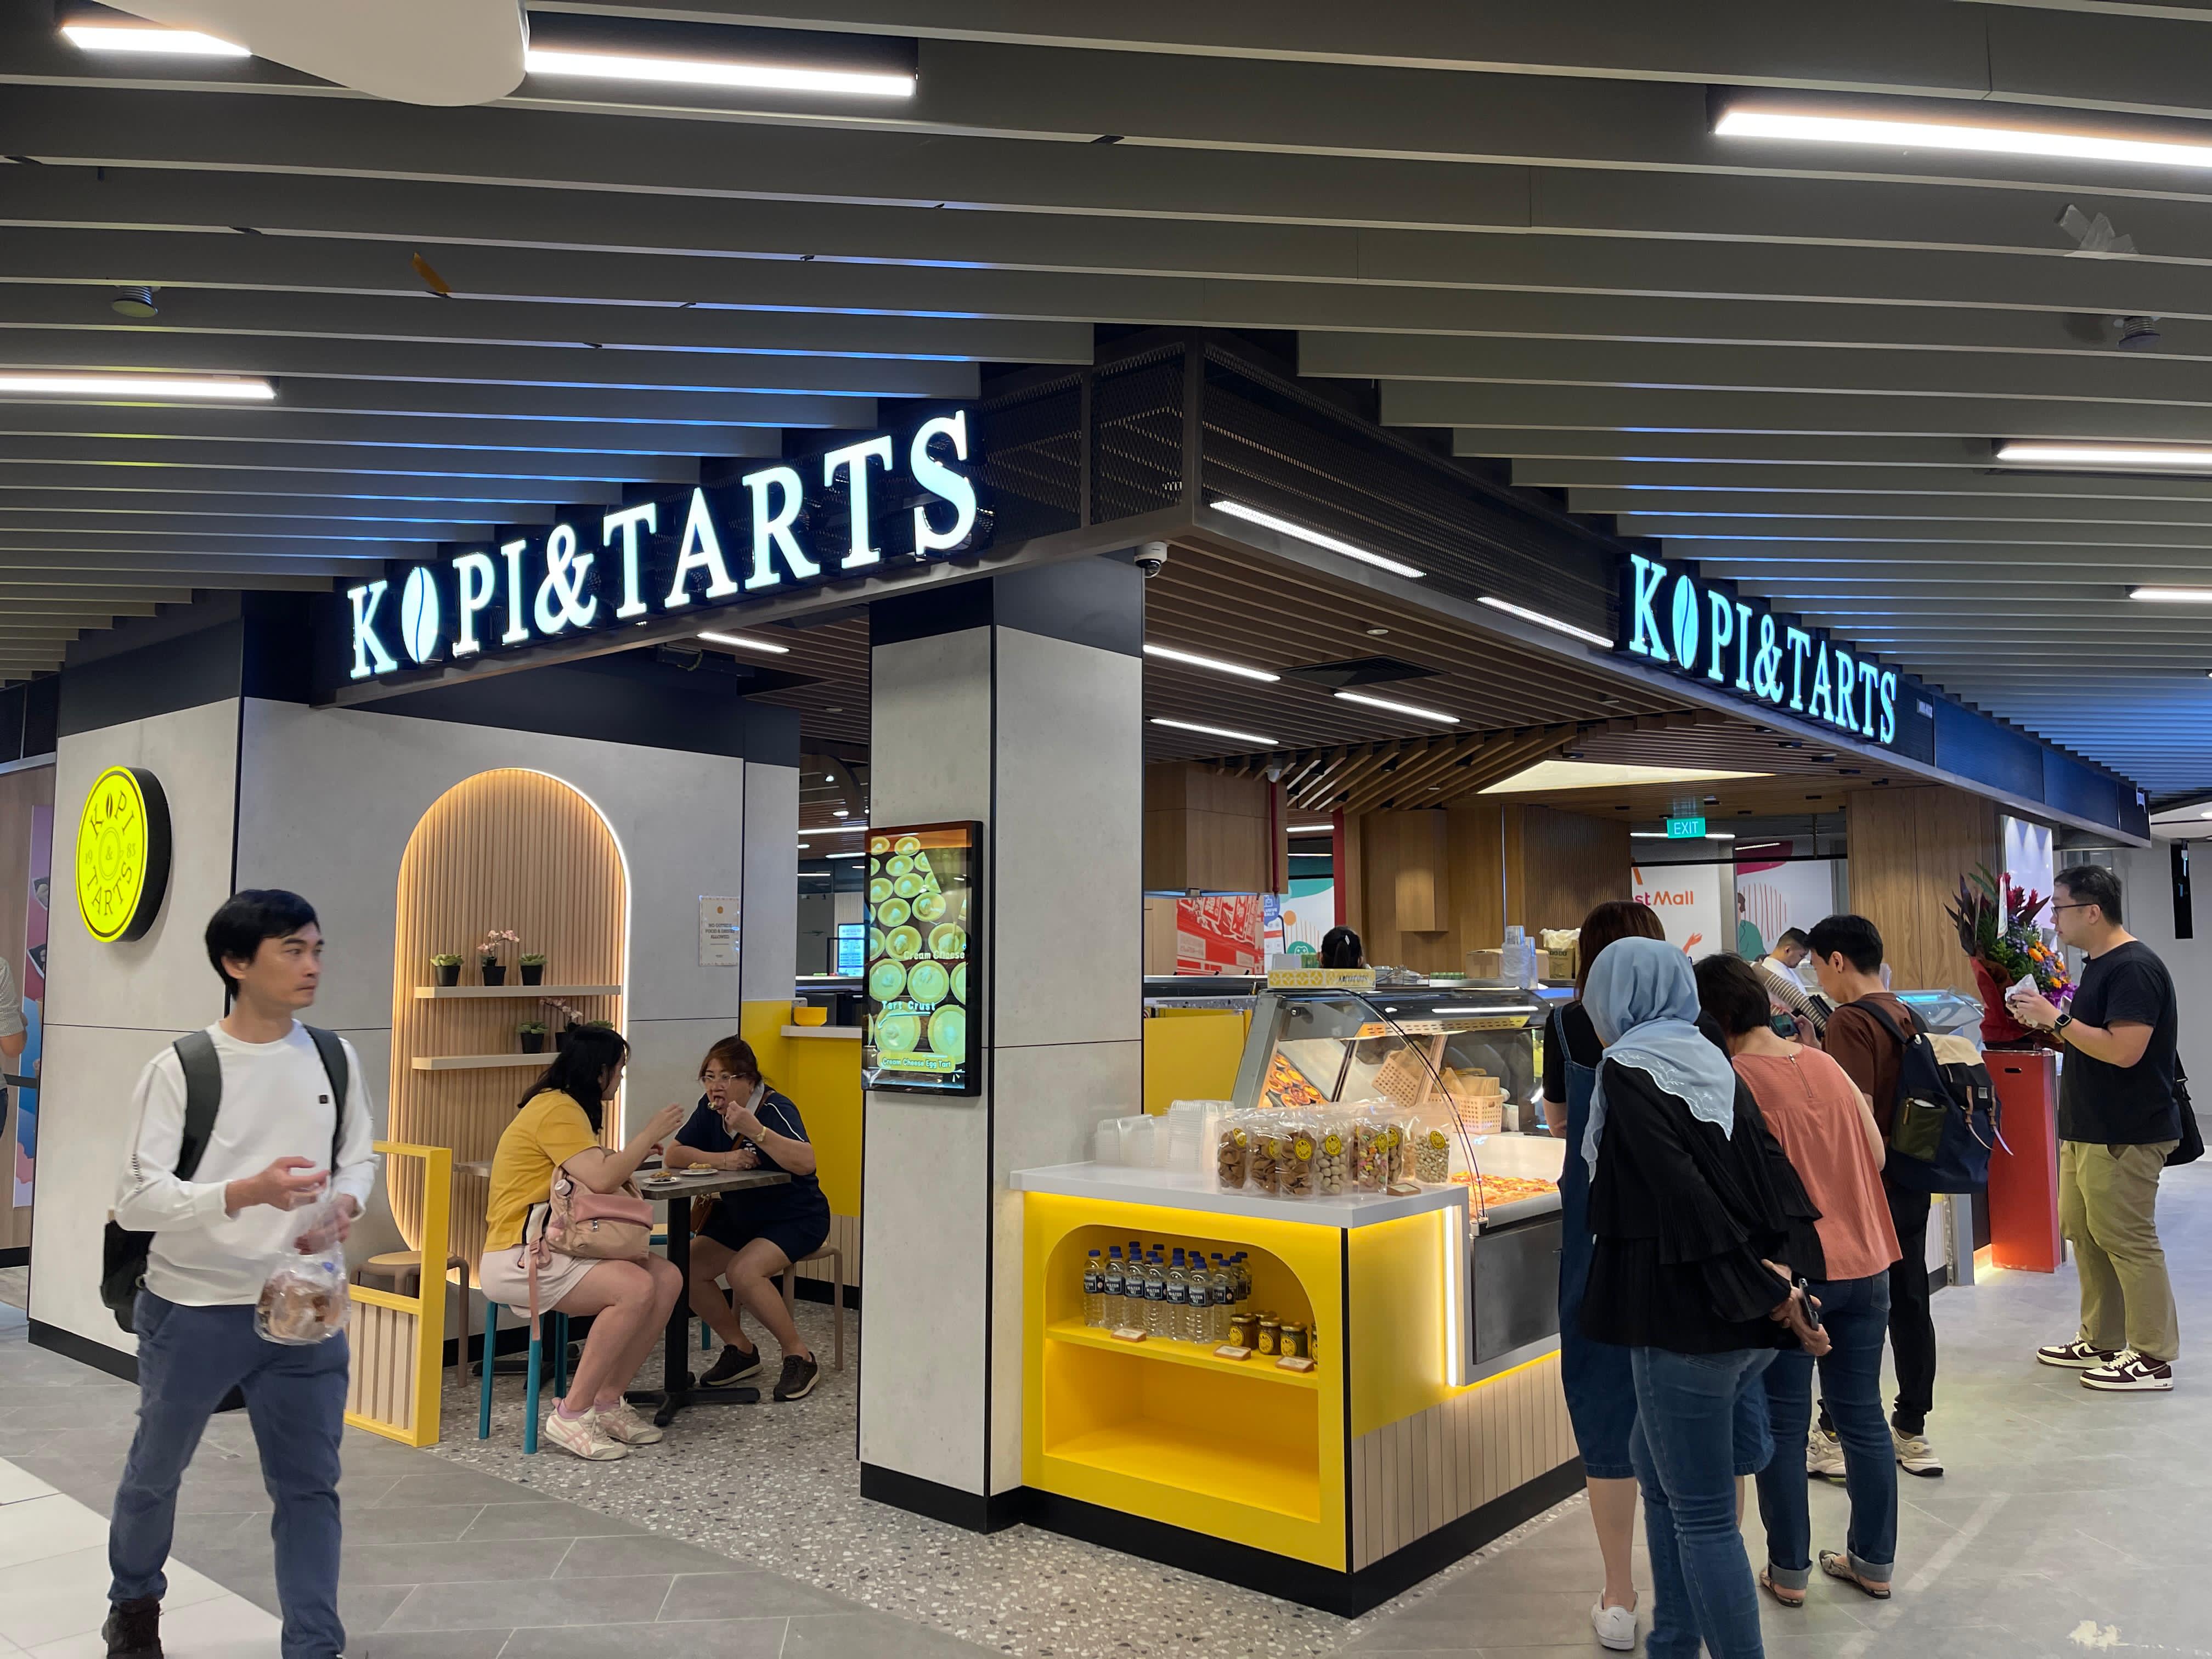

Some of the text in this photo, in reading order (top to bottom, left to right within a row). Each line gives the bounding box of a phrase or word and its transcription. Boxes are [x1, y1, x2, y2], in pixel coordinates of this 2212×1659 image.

[1674, 821, 1699, 834] EXIT
[87, 860, 132, 916] TARTS
[904, 950, 965, 960] Cream Cheese
[882, 1001, 935, 1011] Tart Crust
[882, 1058, 900, 1066] Cream
[902, 1058, 924, 1067] Cheese
[926, 1059, 937, 1069] Egg
